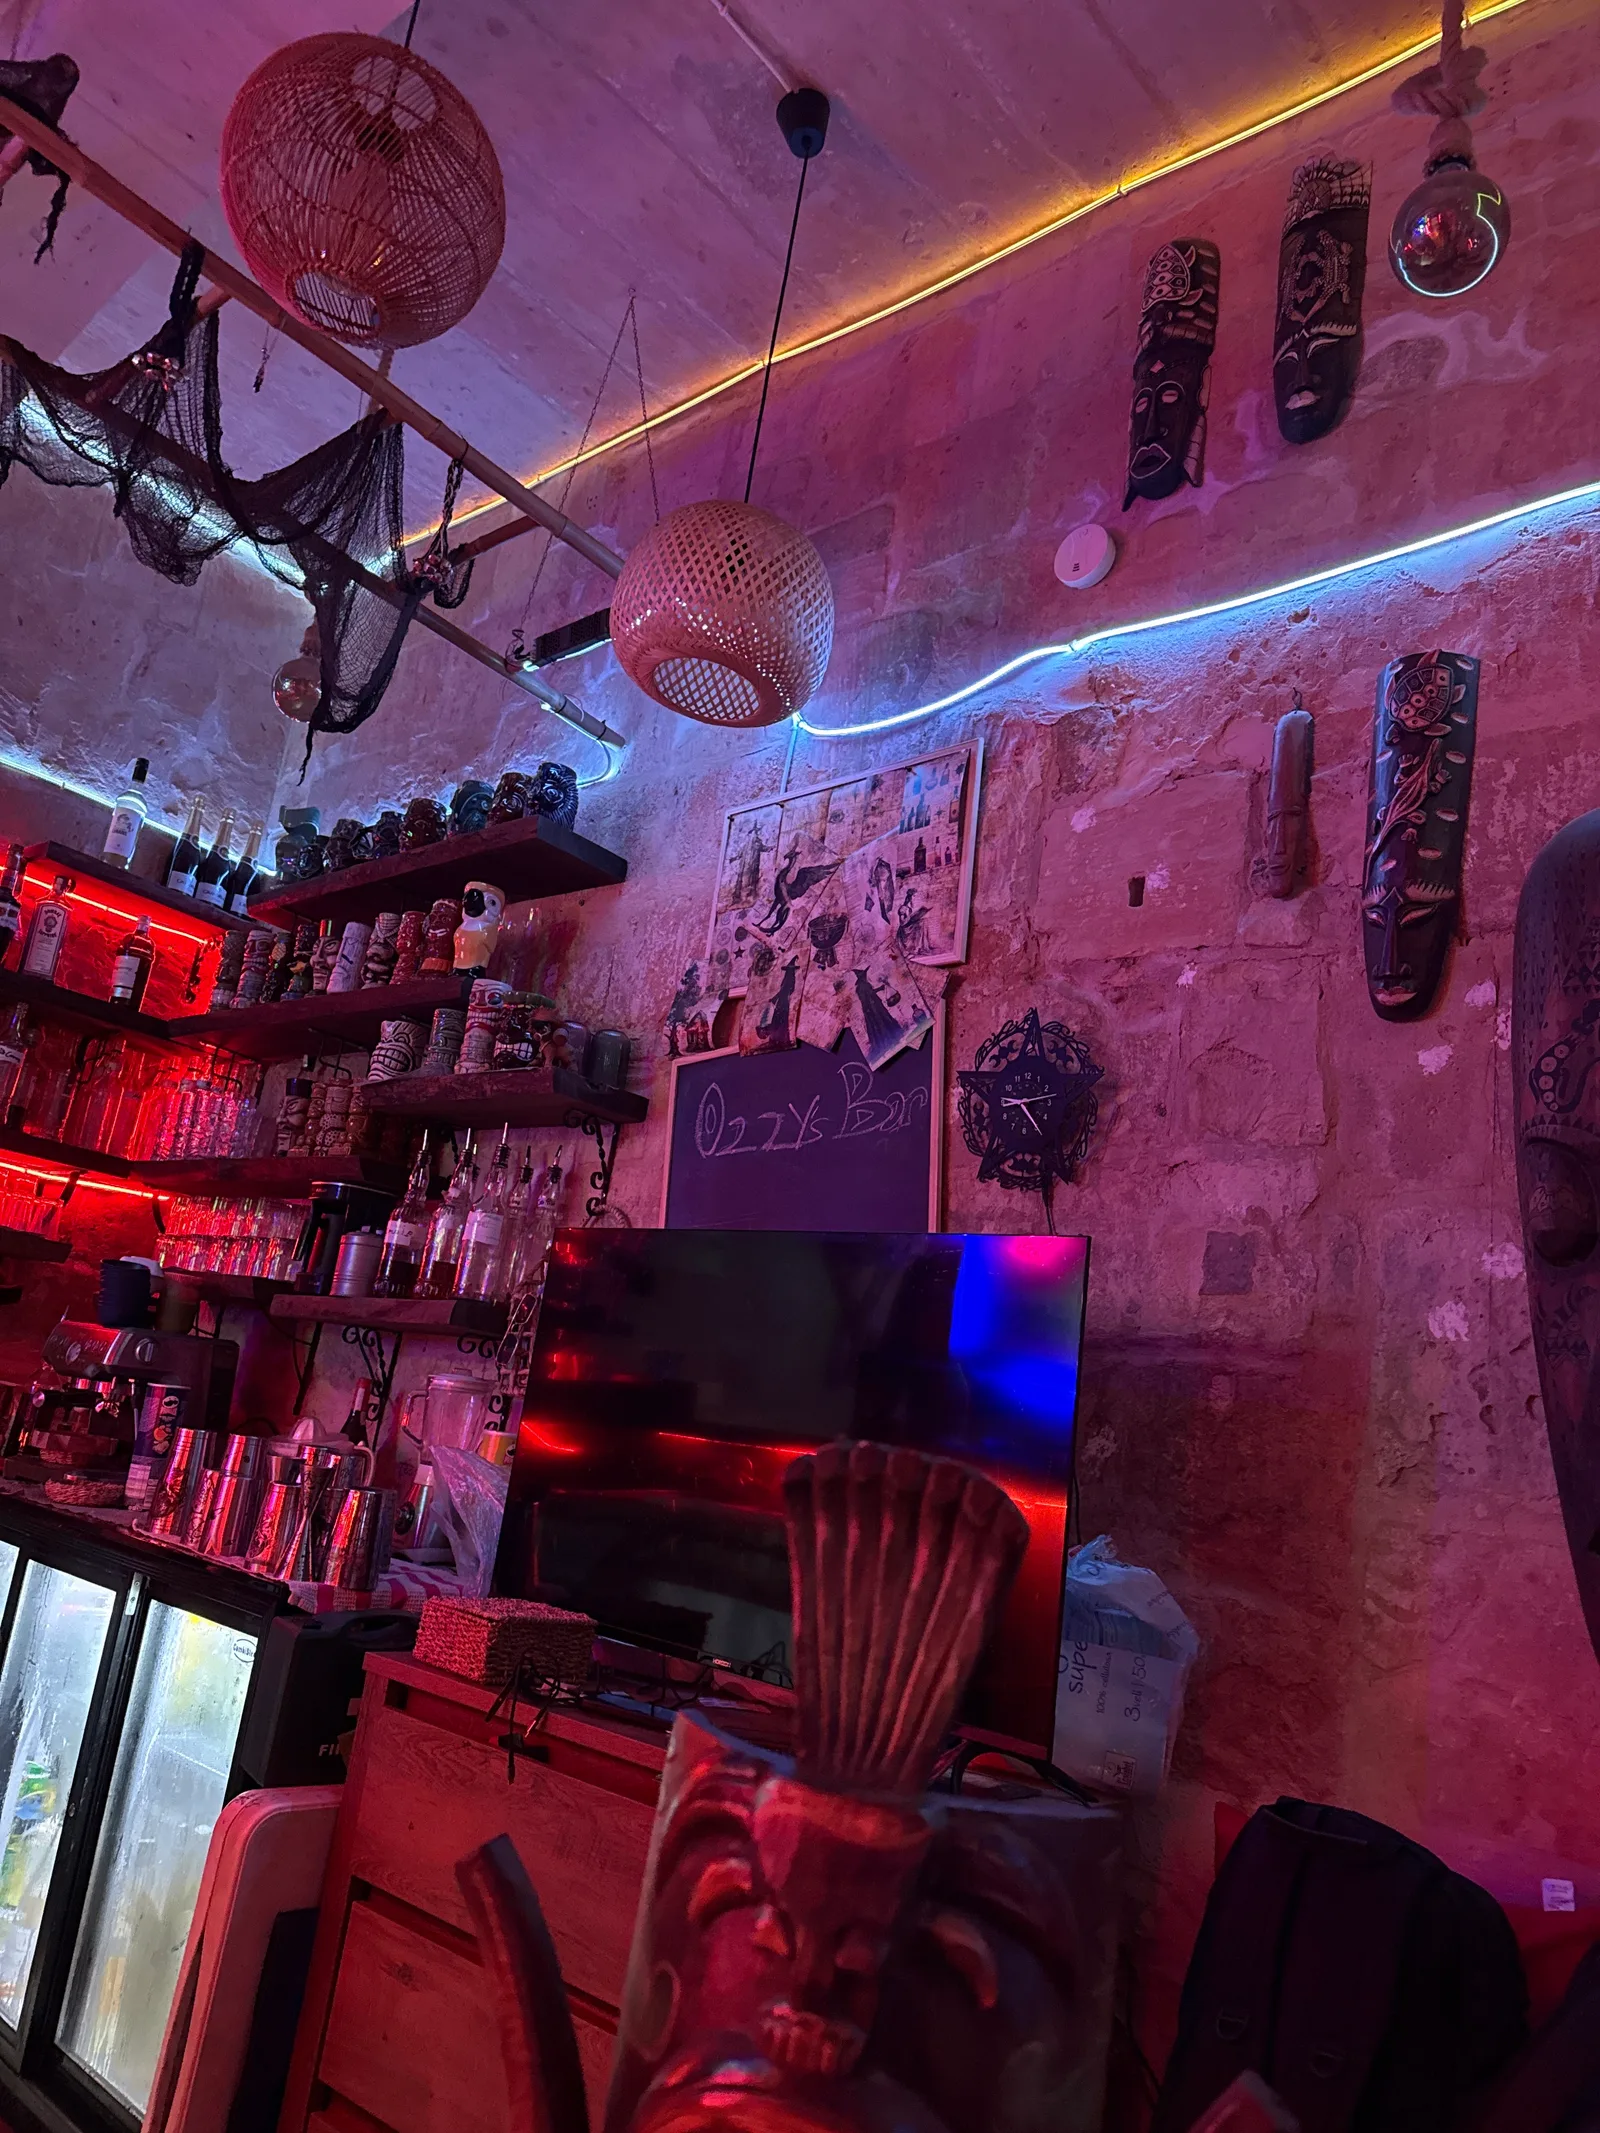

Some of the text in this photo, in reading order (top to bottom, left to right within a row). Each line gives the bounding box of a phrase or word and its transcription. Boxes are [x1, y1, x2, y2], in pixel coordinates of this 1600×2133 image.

[1014, 1075, 1021, 1083] 11
[1037, 1075, 1041, 1083] 1
[1005, 1084, 1013, 1092] 10
[1044, 1084, 1049, 1092] 2
[1047, 1098, 1052, 1107] 3
[1002, 1112, 1008, 1120] 8
[1042, 1113, 1048, 1121] 4
[1011, 1123, 1016, 1131] 7
[1021, 1127, 1027, 1135] 6
